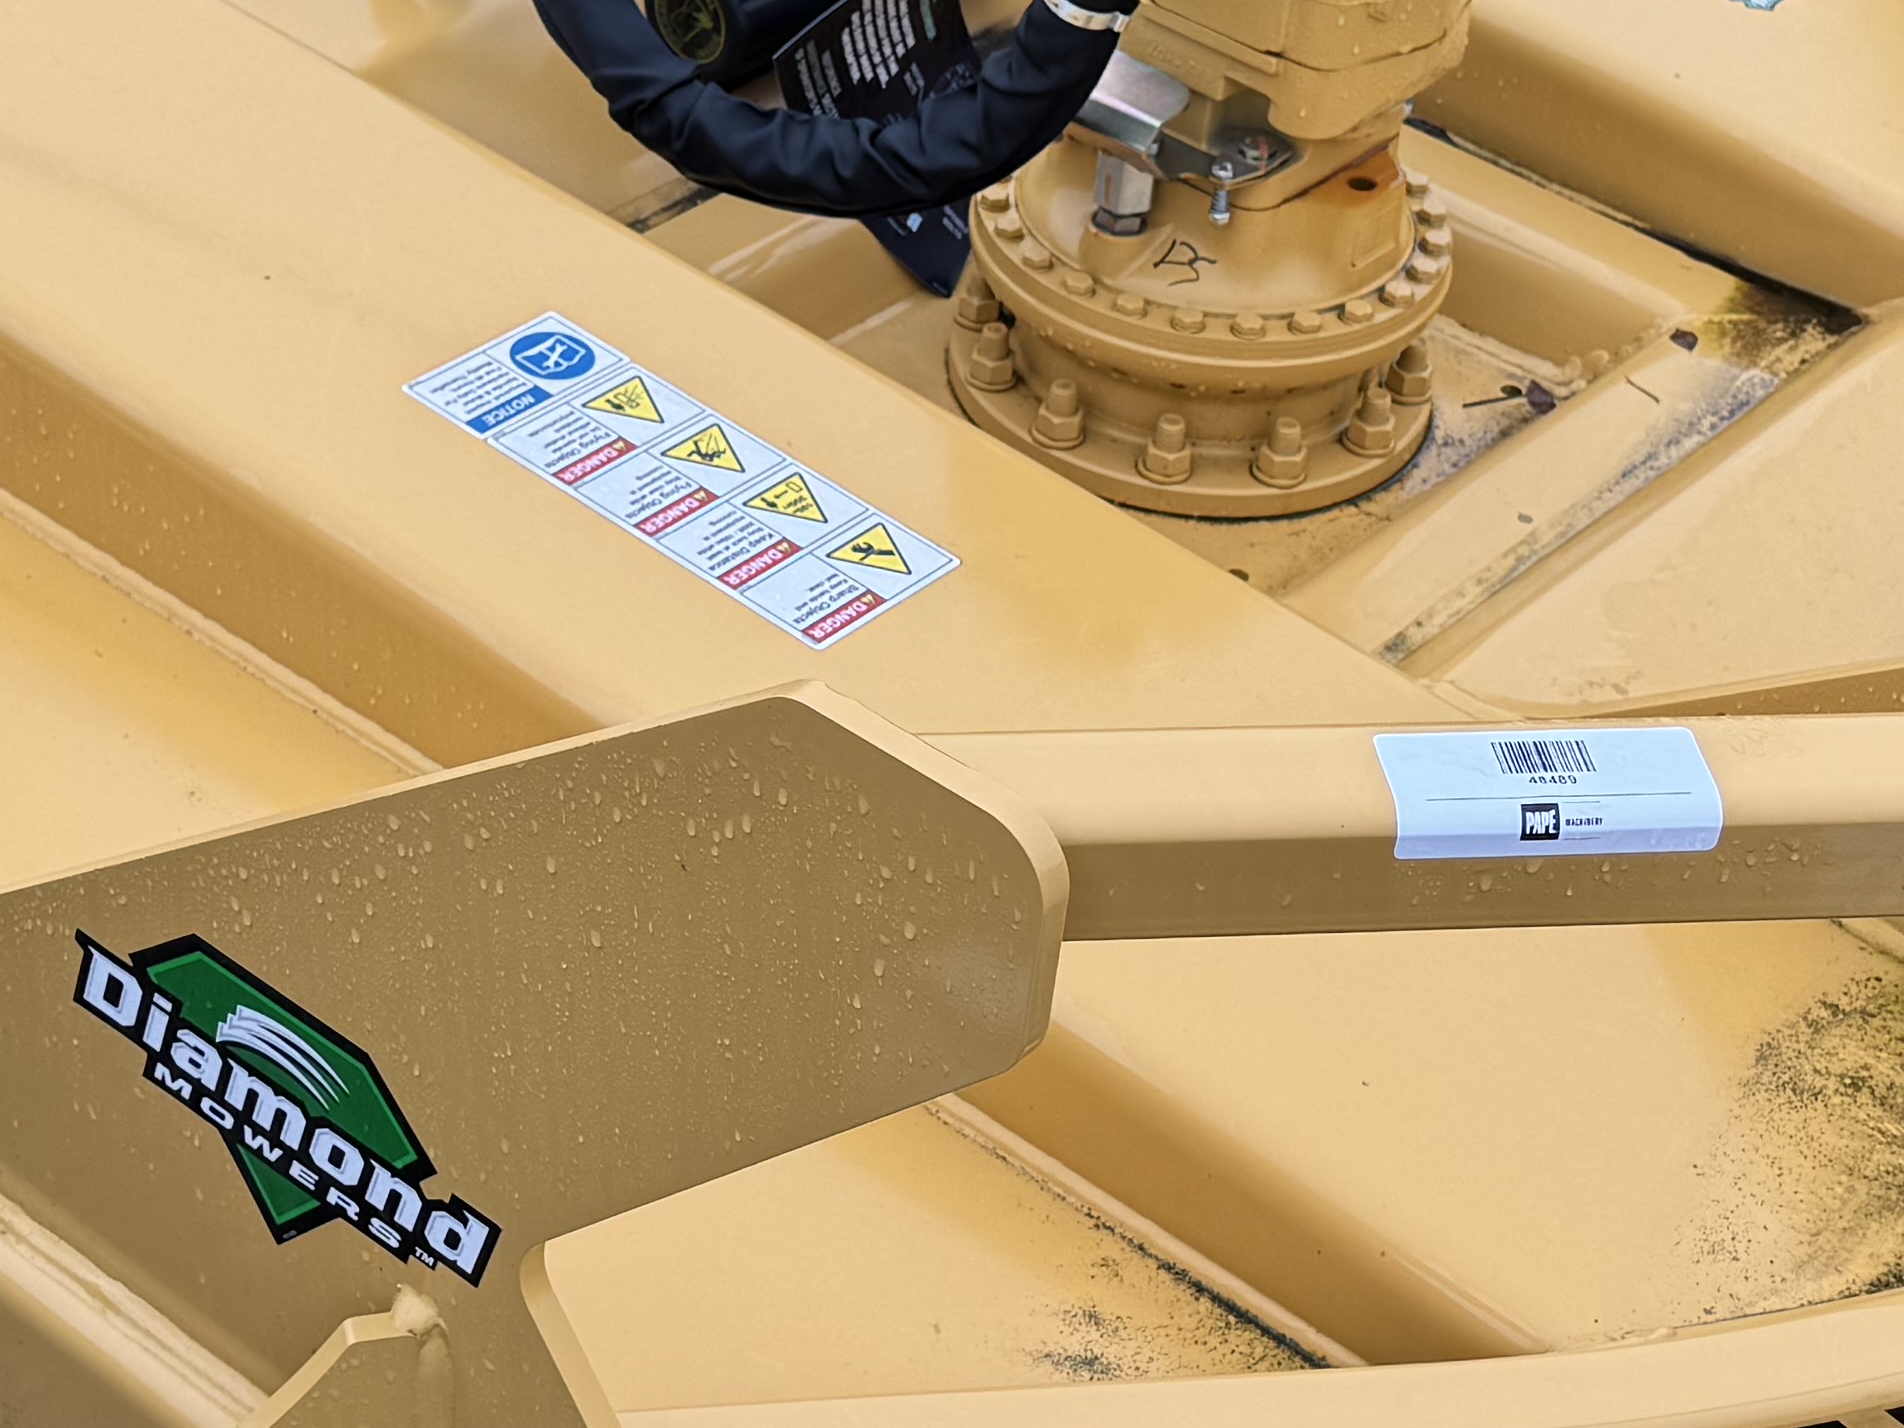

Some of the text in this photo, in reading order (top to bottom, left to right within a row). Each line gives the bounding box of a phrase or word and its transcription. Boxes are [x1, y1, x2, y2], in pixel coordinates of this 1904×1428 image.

[479, 393, 537, 426] NOTICE
[556, 446, 620, 483] DANGER
[638, 496, 701, 533] DANGER
[720, 547, 784, 586] DANGER
[806, 600, 869, 639] DANGER
[83, 944, 490, 1276] Diamond
[153, 1061, 403, 1250] MOWERS
